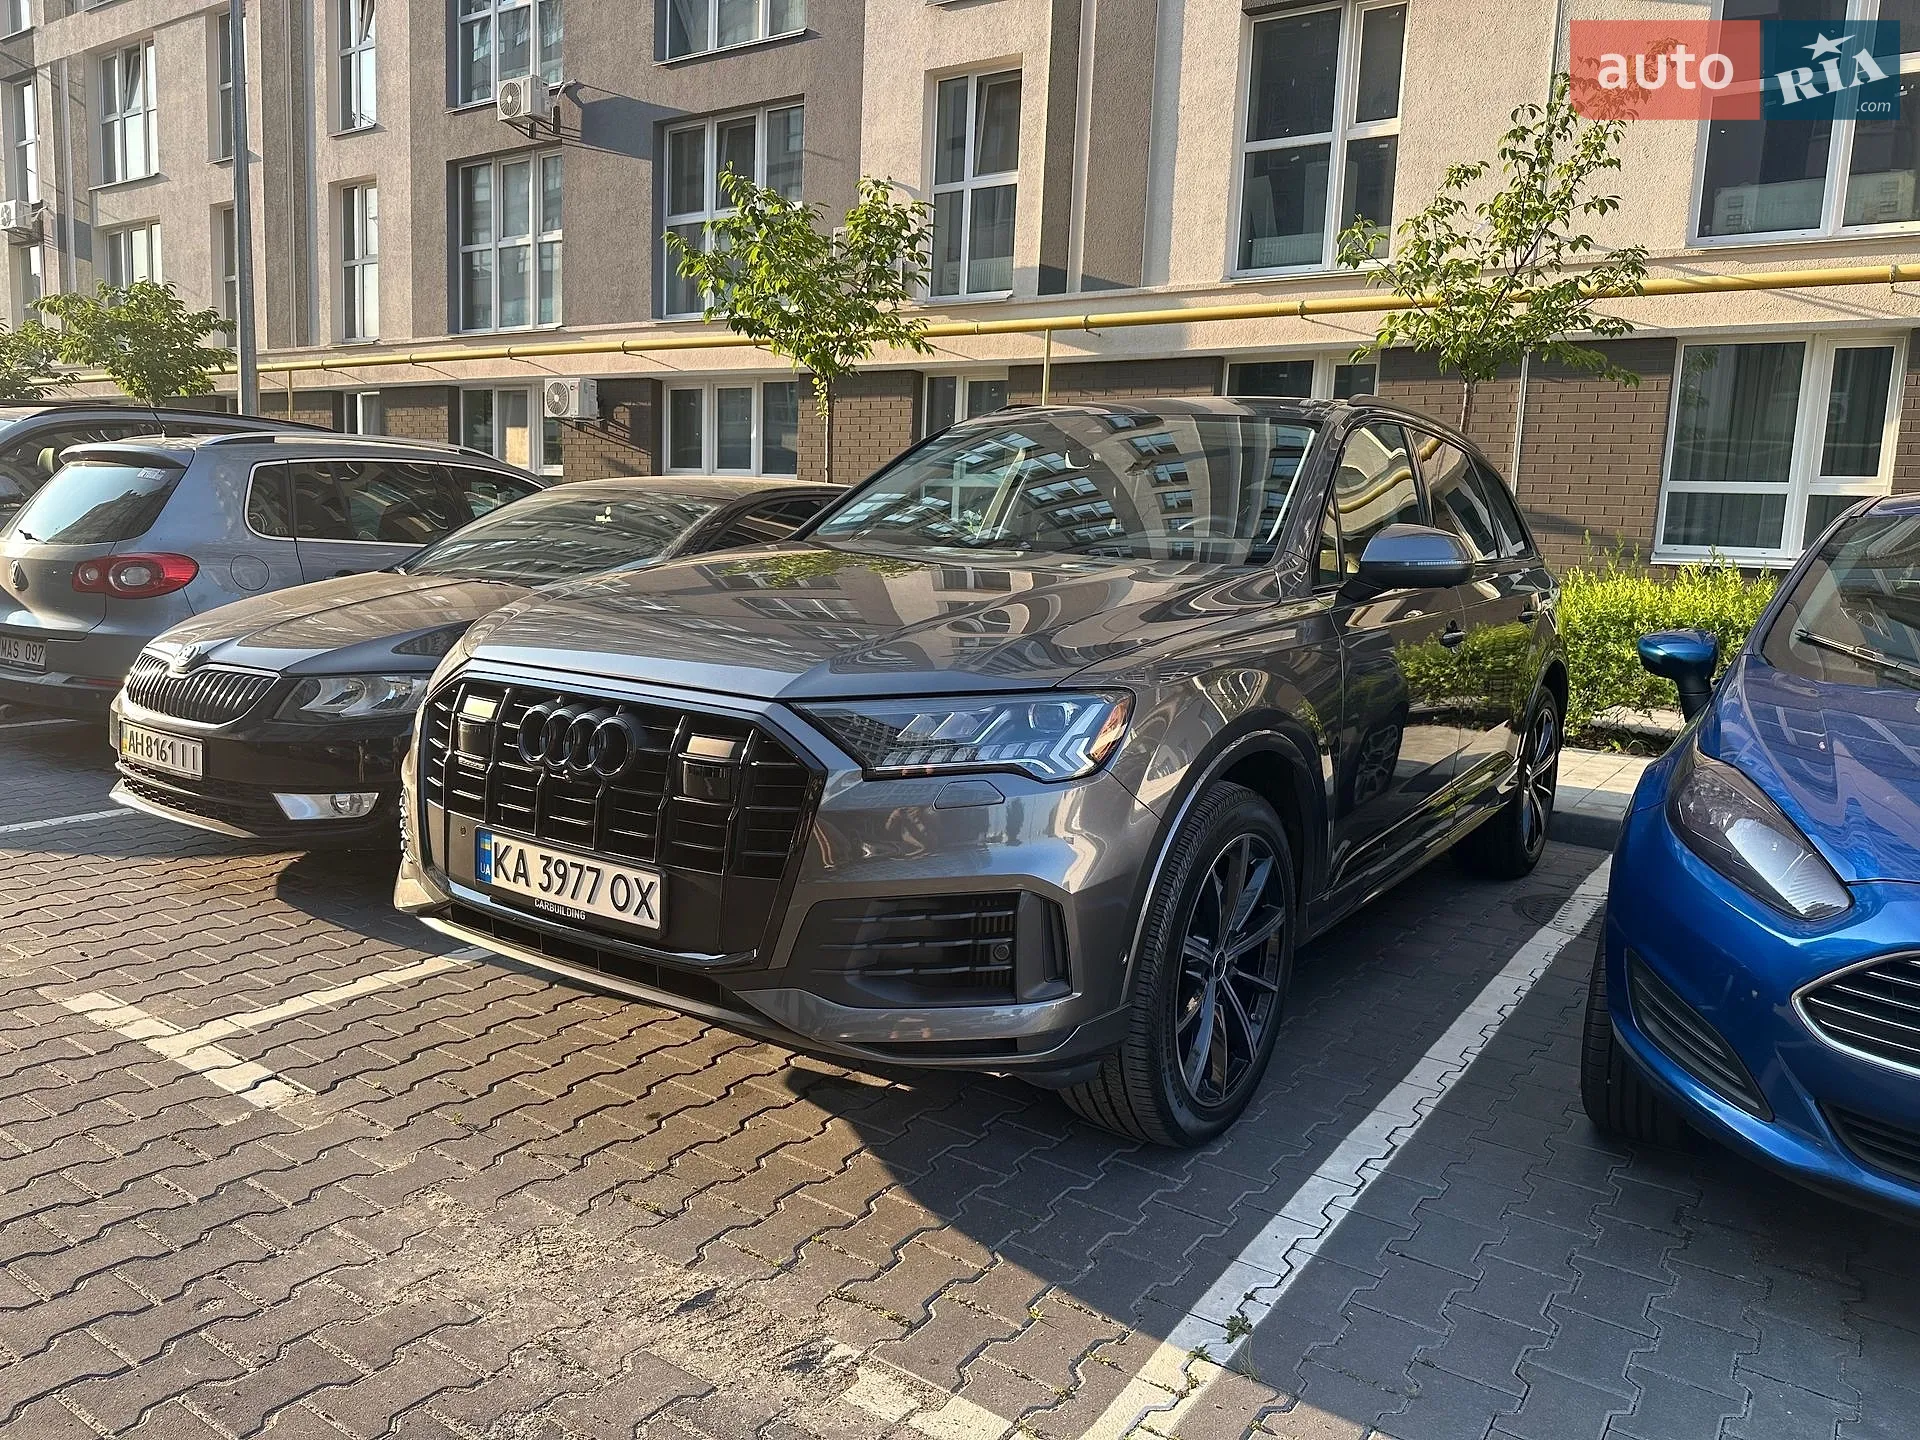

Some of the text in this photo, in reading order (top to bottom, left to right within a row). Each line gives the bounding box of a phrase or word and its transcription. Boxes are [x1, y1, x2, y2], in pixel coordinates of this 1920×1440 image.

[25, 643, 44, 663] 097
[479, 862, 491, 876] UA
[494, 841, 656, 920] KA 3977 OX
[534, 898, 587, 921] CARBUILDING
